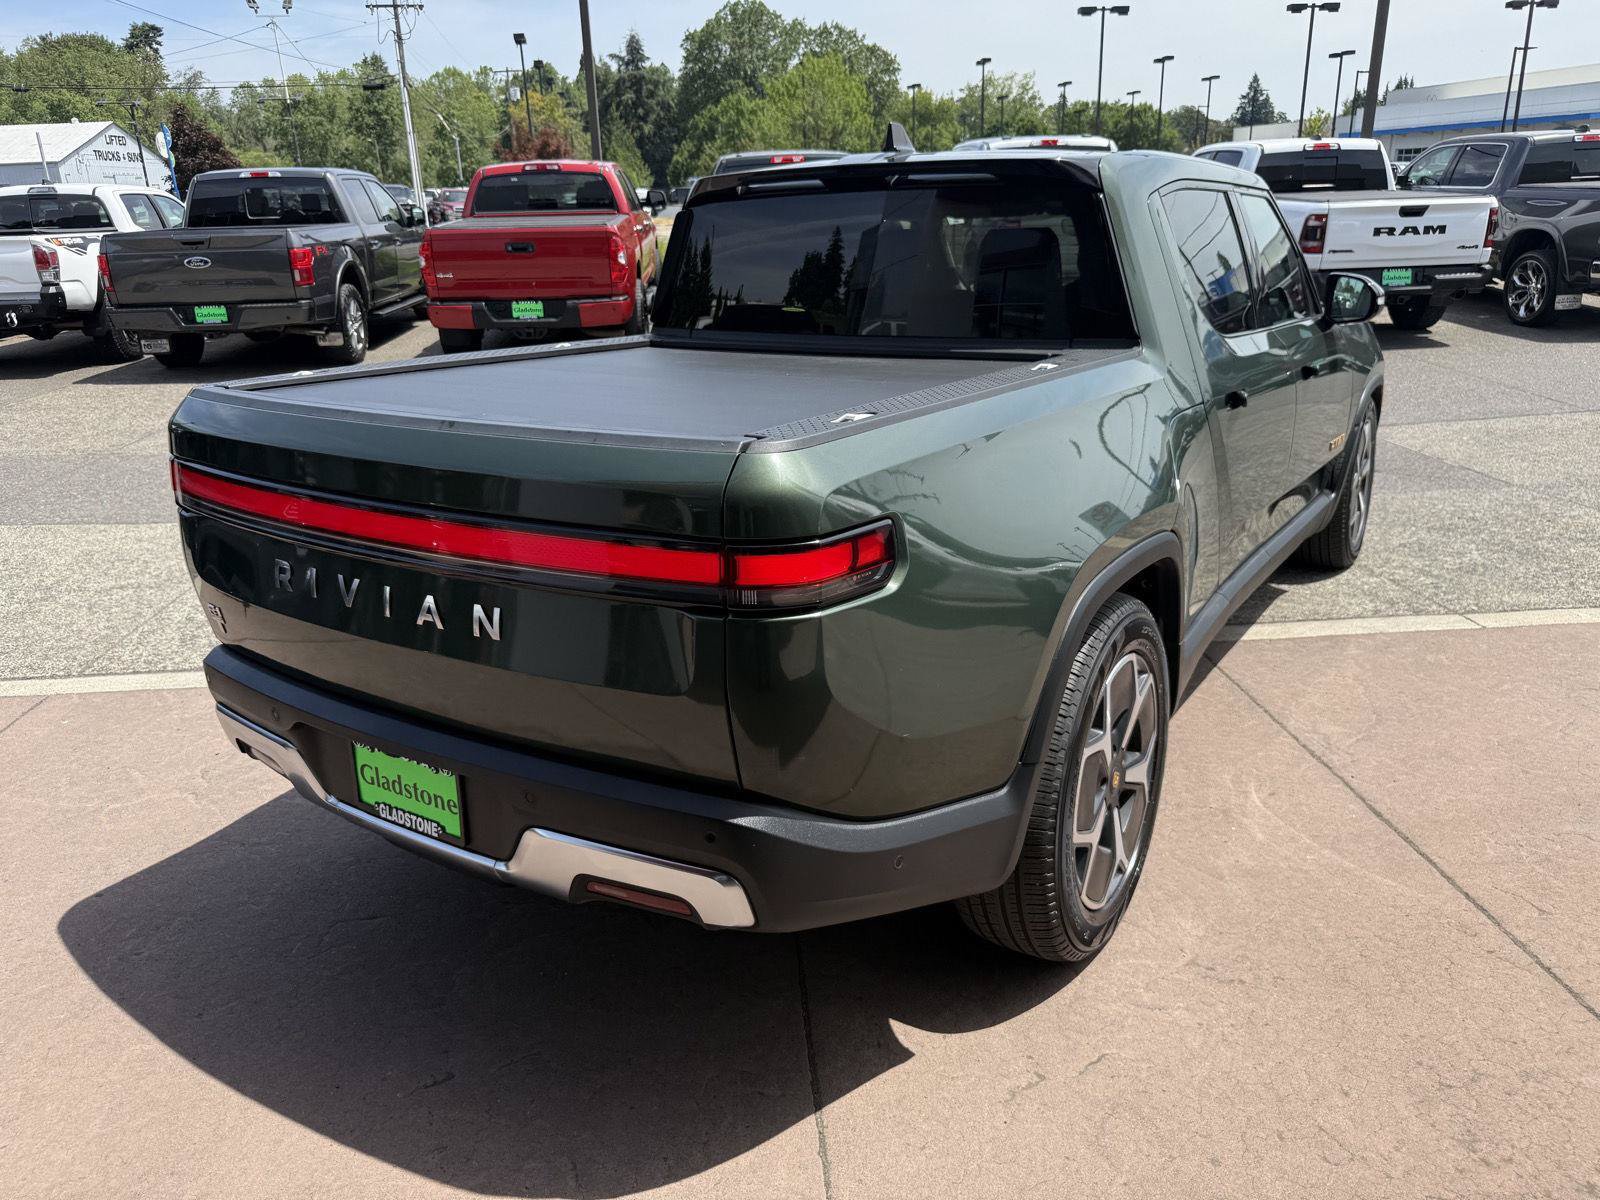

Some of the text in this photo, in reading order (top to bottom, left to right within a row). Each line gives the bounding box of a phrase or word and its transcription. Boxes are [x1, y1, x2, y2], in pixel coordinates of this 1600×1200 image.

[104, 134, 127, 146] LIFTED
[93, 150, 121, 162] TRUCKS
[1373, 225, 1447, 237] RAM
[275, 558, 501, 641] RIVIAN
[360, 763, 459, 815] Gladstone
[379, 803, 440, 837] GLADSTONE
